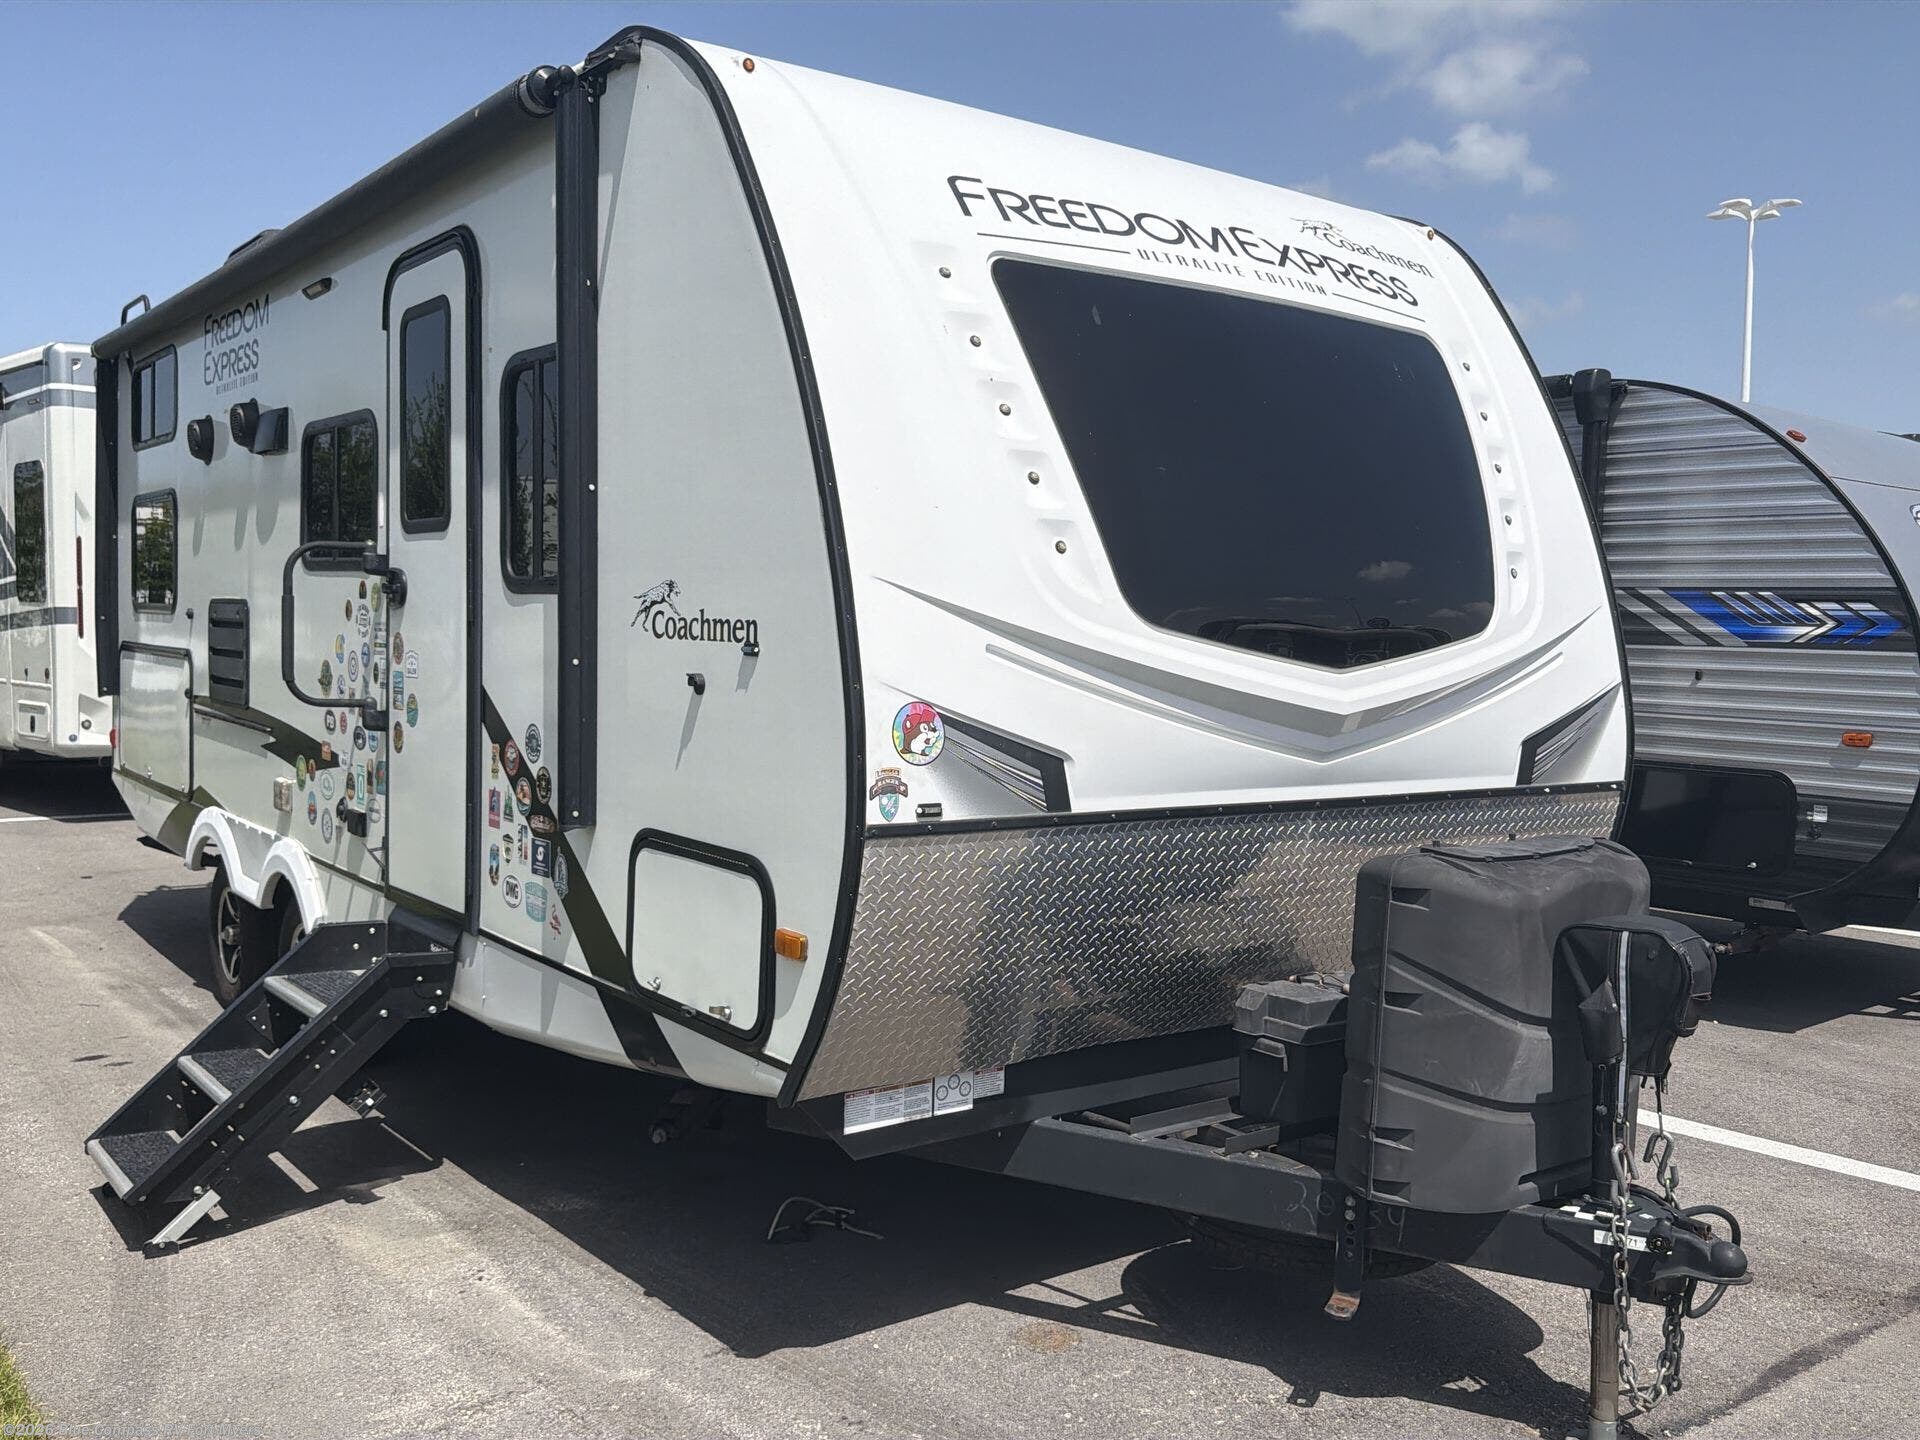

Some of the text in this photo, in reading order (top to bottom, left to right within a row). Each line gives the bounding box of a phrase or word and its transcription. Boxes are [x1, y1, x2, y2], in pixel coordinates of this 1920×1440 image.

[1136, 248, 1328, 297] ULTRALITE EDITION
[1323, 229, 1434, 279] Coachmen
[203, 293, 270, 351] FREEDOM
[203, 338, 260, 386] EXPRESS
[652, 608, 758, 644] Coachmen
